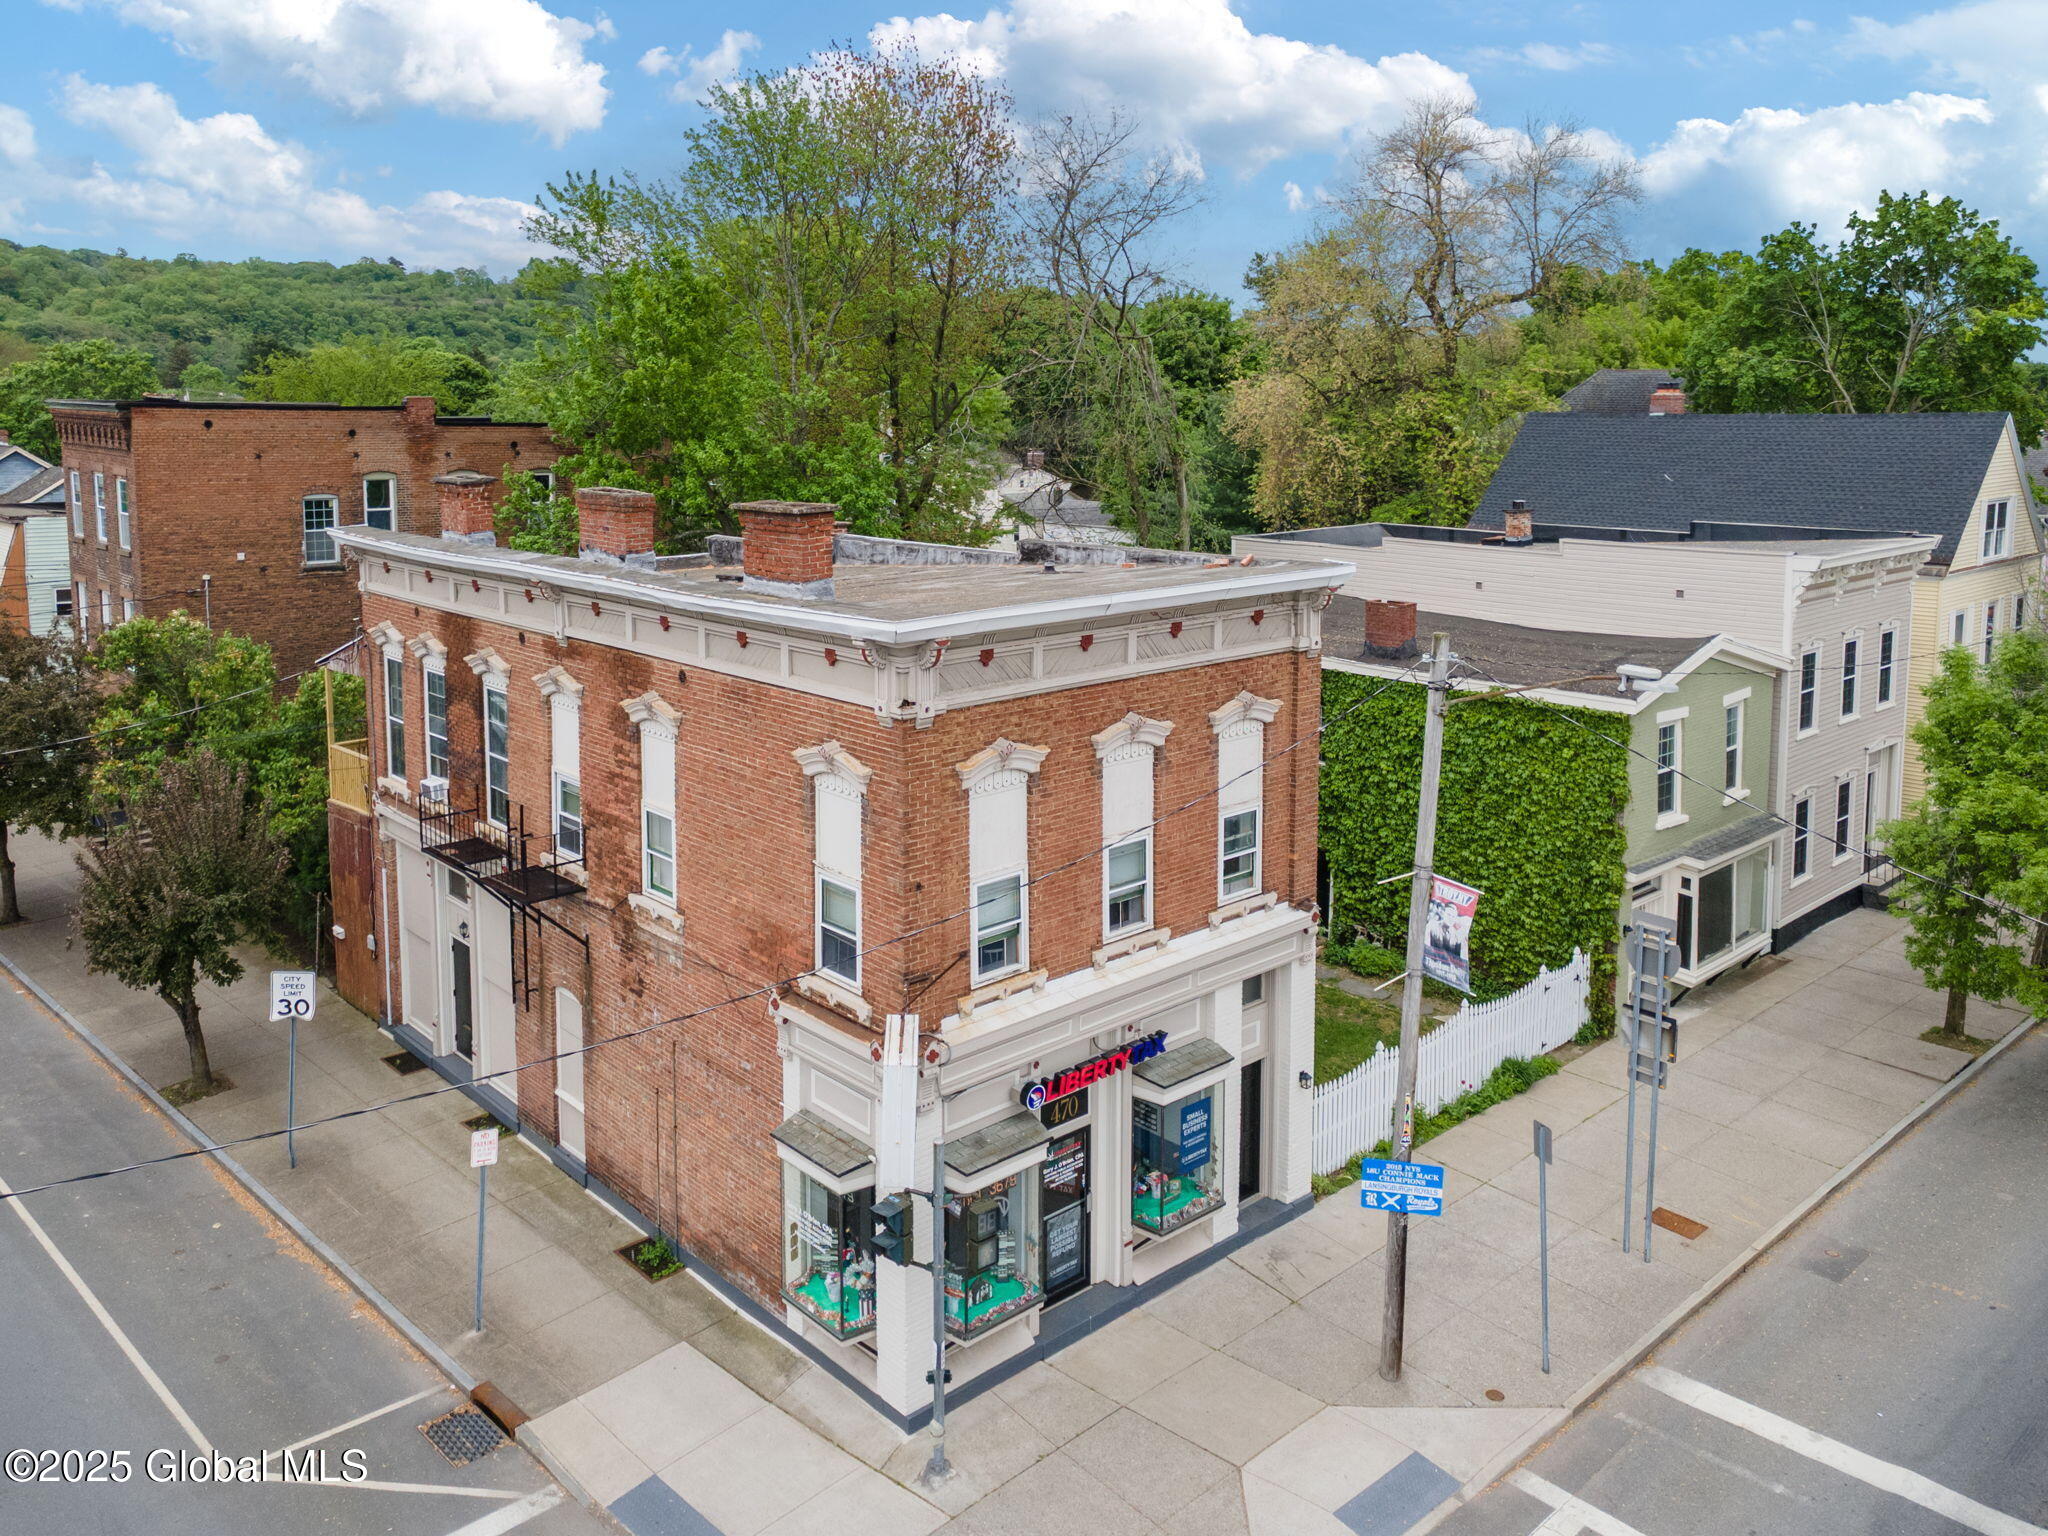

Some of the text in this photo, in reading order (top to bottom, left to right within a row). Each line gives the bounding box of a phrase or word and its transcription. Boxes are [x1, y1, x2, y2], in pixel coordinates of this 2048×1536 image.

[277, 998, 310, 1016] 30
[1044, 1031, 1168, 1102] LIBERTY TAX
[1051, 1096, 1079, 1123] 470
[1187, 1109, 1204, 1121] SMALL
[1182, 1114, 1208, 1130] BUSINESS
[1183, 1121, 1207, 1136] EXPERTS
[1379, 1175, 1426, 1186] CHAMPIONS
[1382, 1169, 1414, 1178] CONNIE
[1417, 1173, 1440, 1181] MACK
[1050, 1220, 1079, 1238] GET YOUR
[1051, 1227, 1077, 1244] LARGEST
[1050, 1233, 1078, 1252] POSSIBLE
[1051, 1242, 1076, 1258] REFUND
